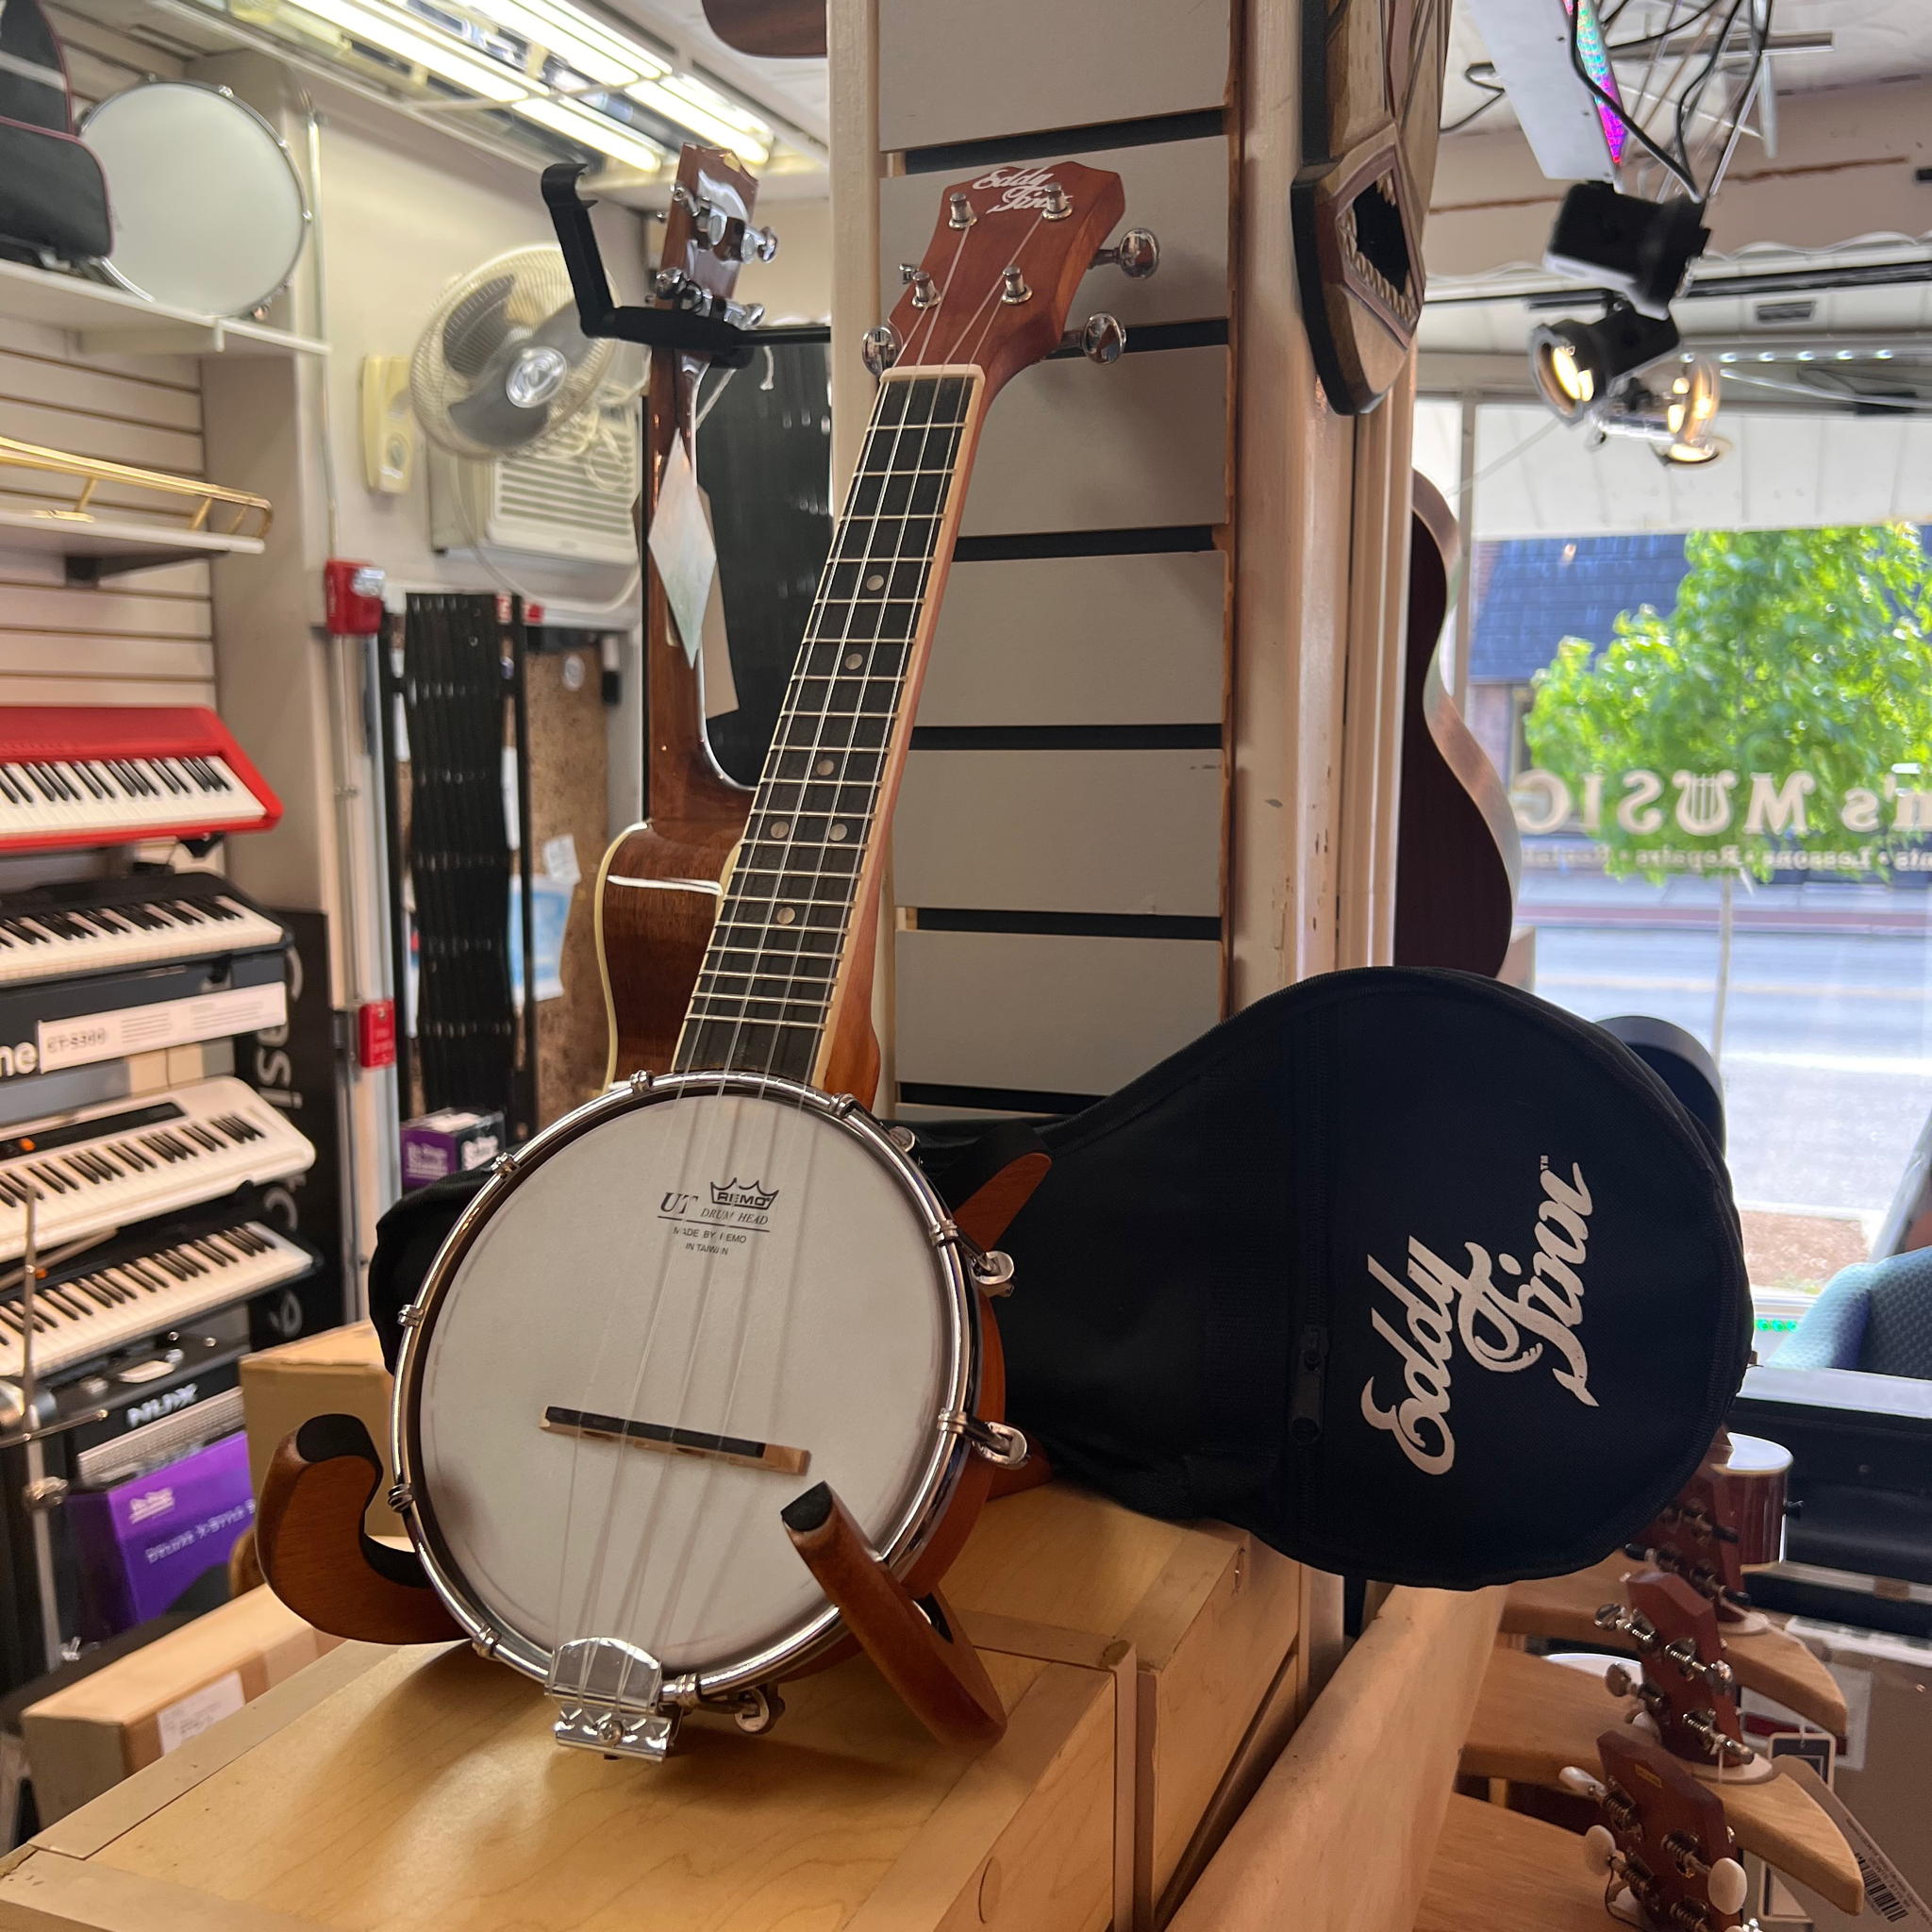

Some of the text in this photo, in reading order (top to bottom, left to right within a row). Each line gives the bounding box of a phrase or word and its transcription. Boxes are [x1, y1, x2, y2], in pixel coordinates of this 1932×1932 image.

[973, 166, 1055, 190] Eddy
[986, 185, 1074, 214] Fin
[660, 1191, 766, 1214] UT REMO
[701, 1208, 769, 1225] DRUM HEAD
[703, 1230, 717, 1239] BY
[685, 1242, 728, 1256] IN TAIWN
[1458, 1161, 1599, 1407] Finn
[1360, 1235, 1455, 1475] Eddy
